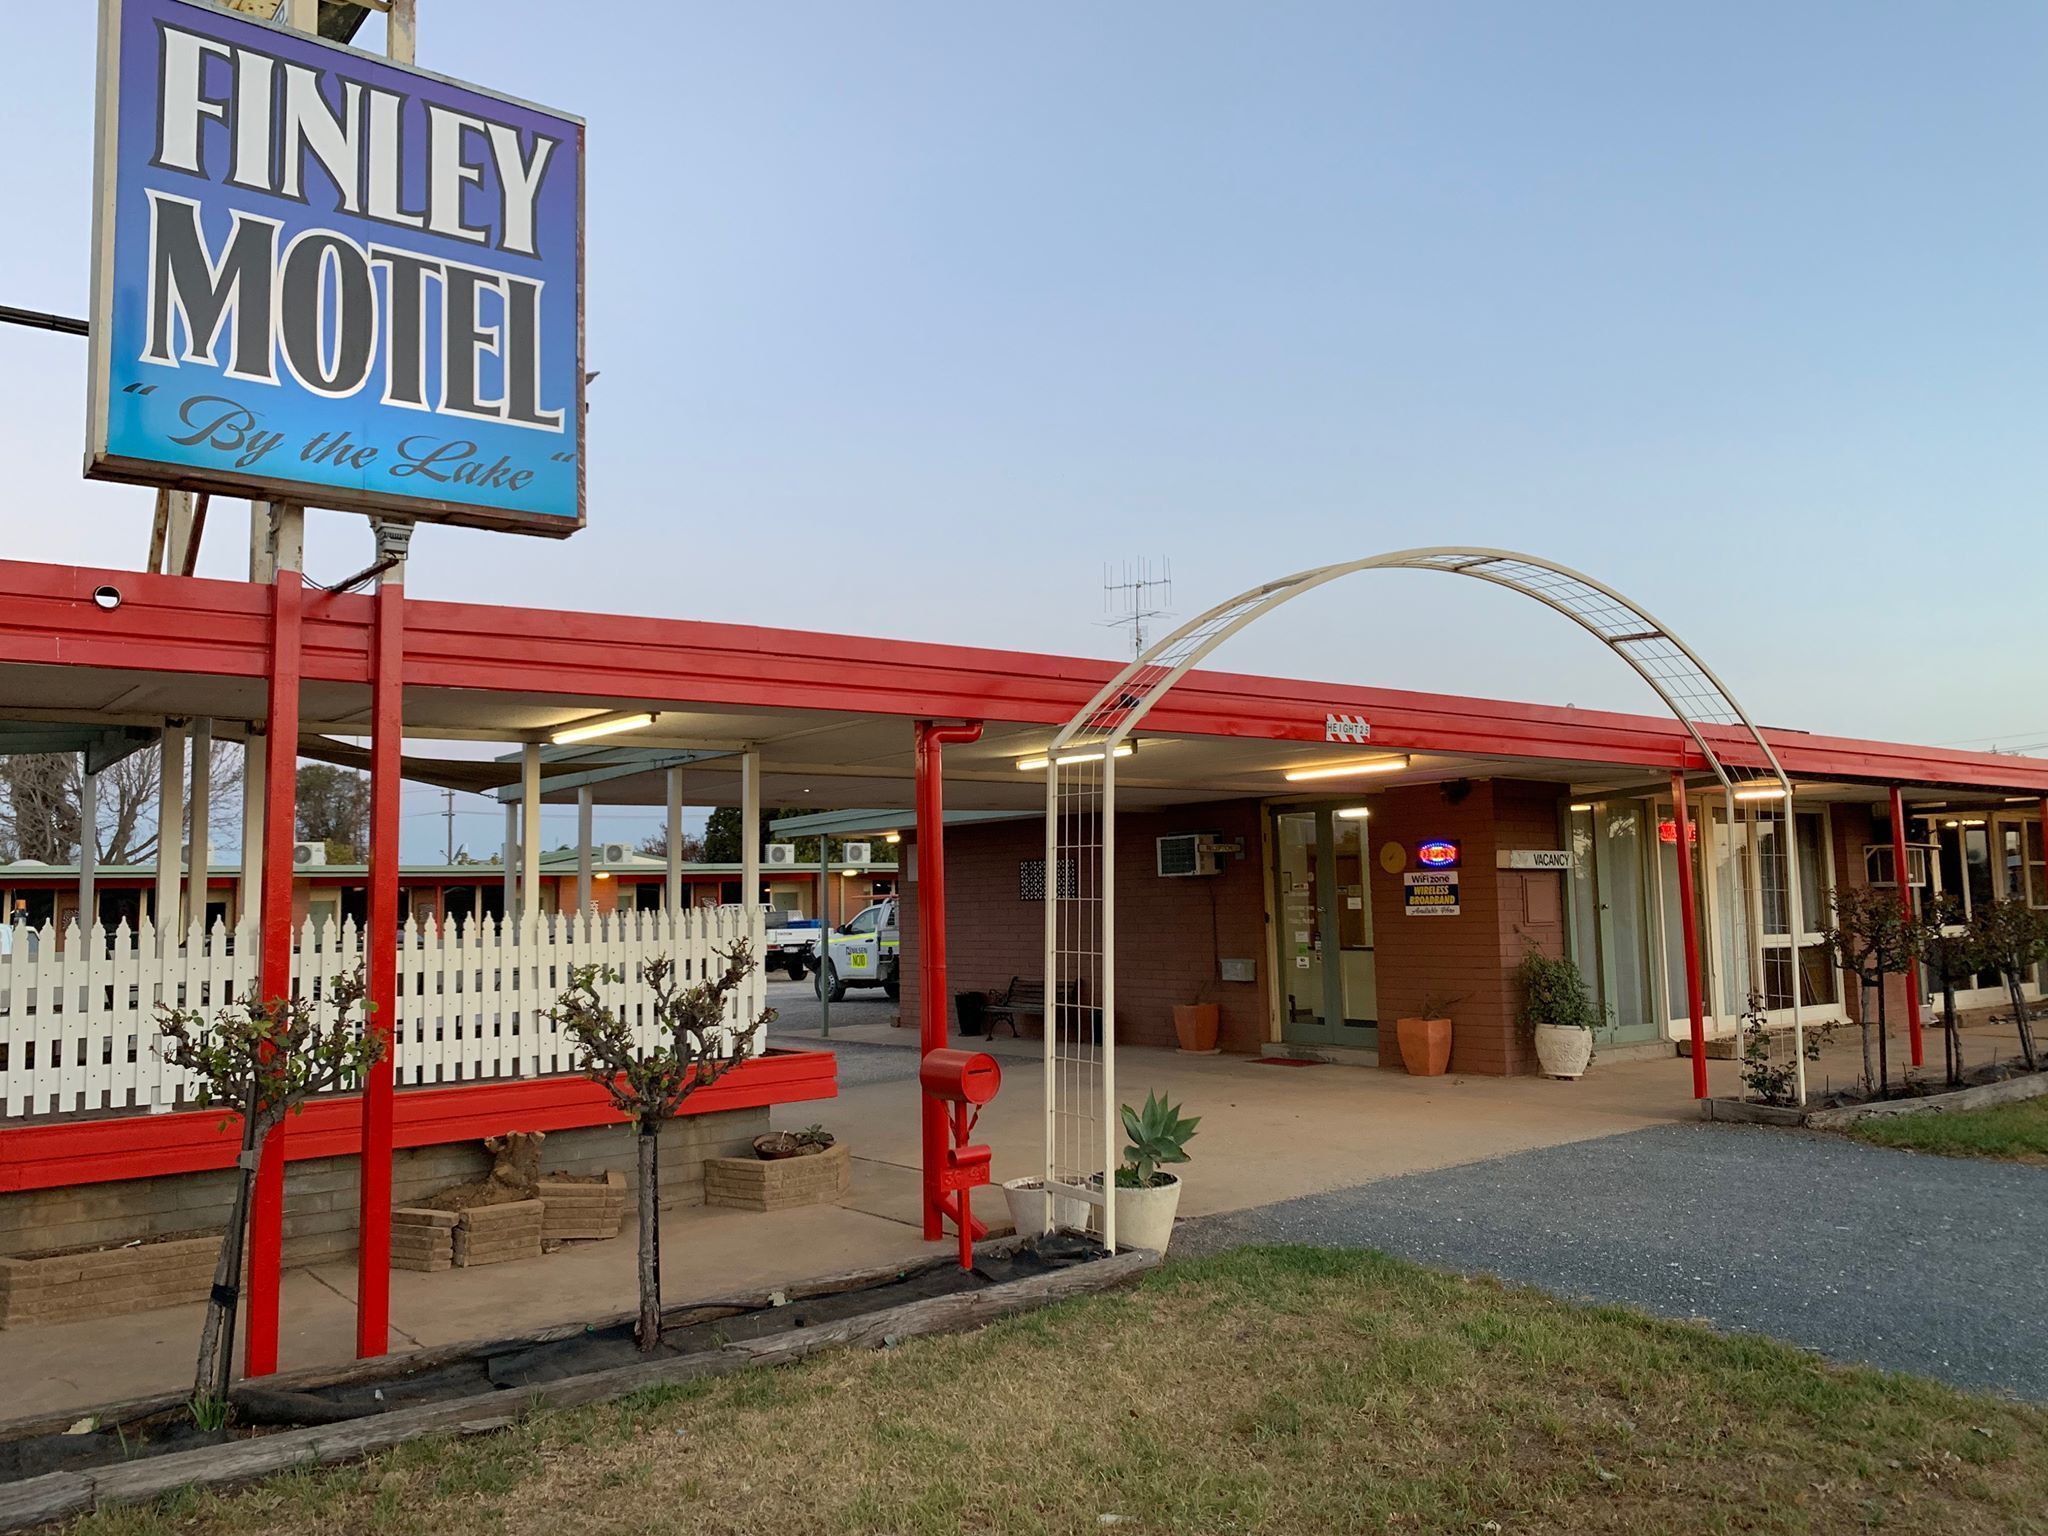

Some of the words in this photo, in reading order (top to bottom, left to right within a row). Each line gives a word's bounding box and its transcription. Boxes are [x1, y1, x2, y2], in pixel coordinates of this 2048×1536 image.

[150, 18, 562, 260] FINLEY
[139, 188, 565, 433] MOTEL
[300, 431, 378, 470] the
[1419, 848, 1456, 860] OPEN
[1533, 853, 1570, 867] VACANCY
[1413, 885, 1449, 895] WIRELESS
[1409, 895, 1456, 905] BROADBAND
